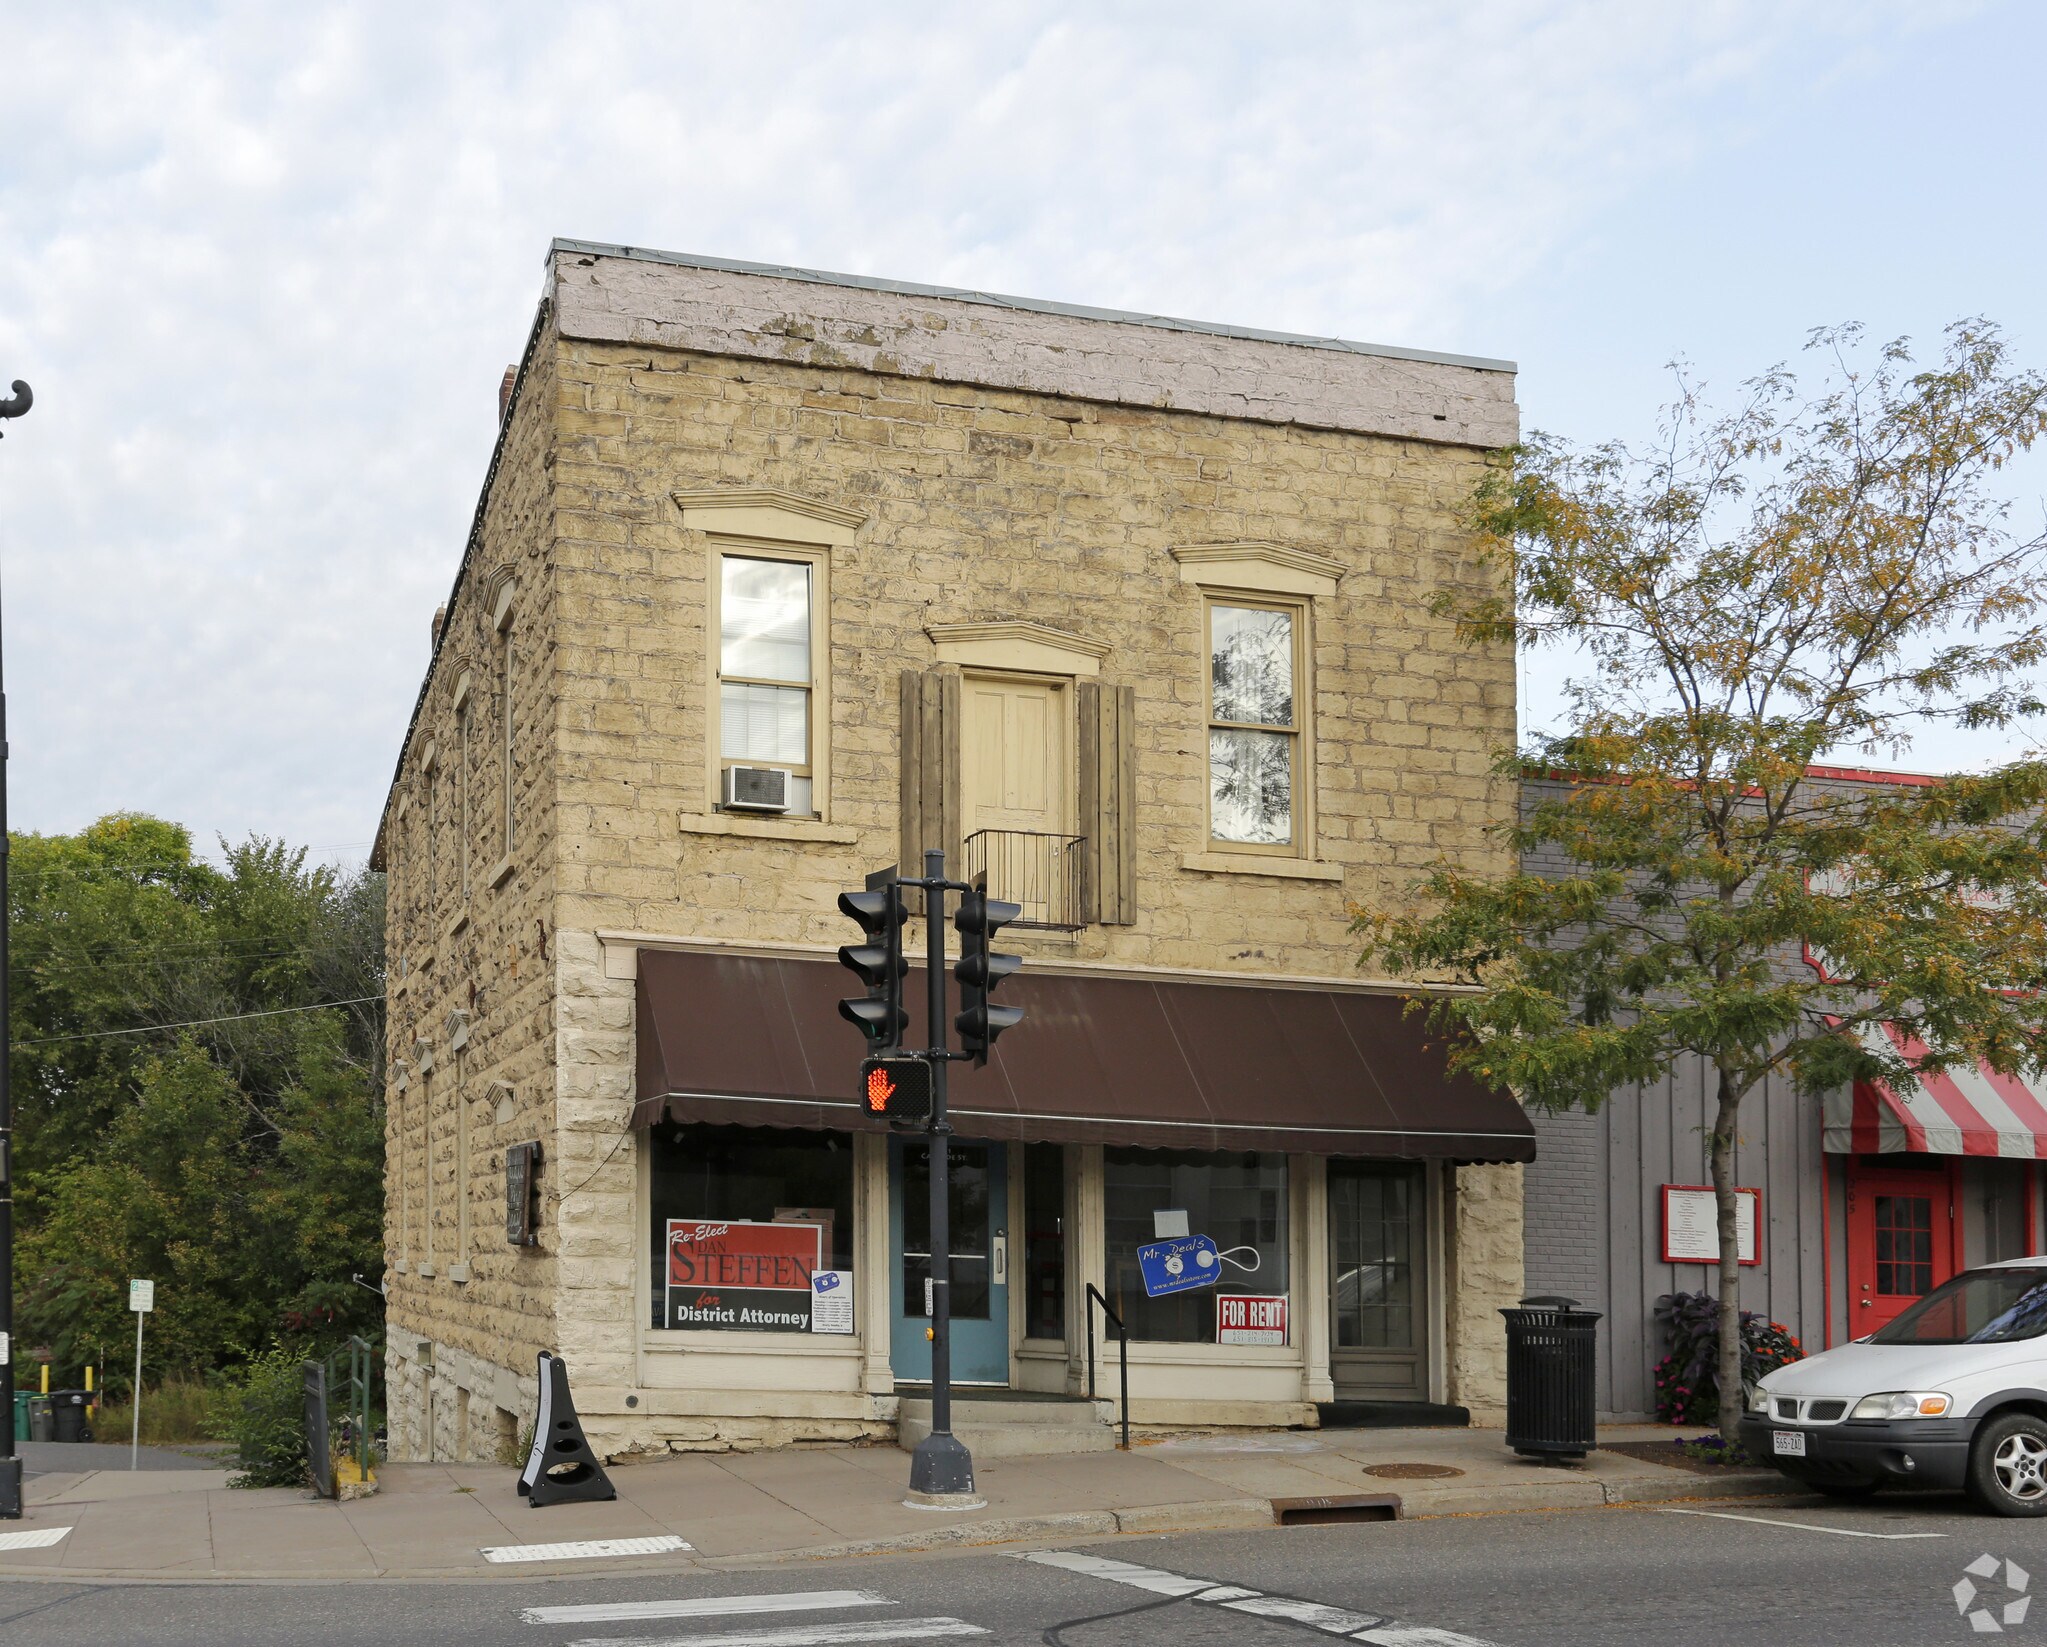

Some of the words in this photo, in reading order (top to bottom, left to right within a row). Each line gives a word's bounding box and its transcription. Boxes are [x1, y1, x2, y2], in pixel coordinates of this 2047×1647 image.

[670, 1224, 728, 1245] Re-Elect
[697, 1240, 727, 1253] DAN
[1169, 1239, 1205, 1254] Deals
[673, 1241, 813, 1287] STEFFEN
[696, 1291, 721, 1309] for
[677, 1305, 735, 1322] District
[740, 1308, 809, 1329] Attorney
[1222, 1300, 1246, 1326] FOR
[1250, 1301, 1283, 1327] RENT
